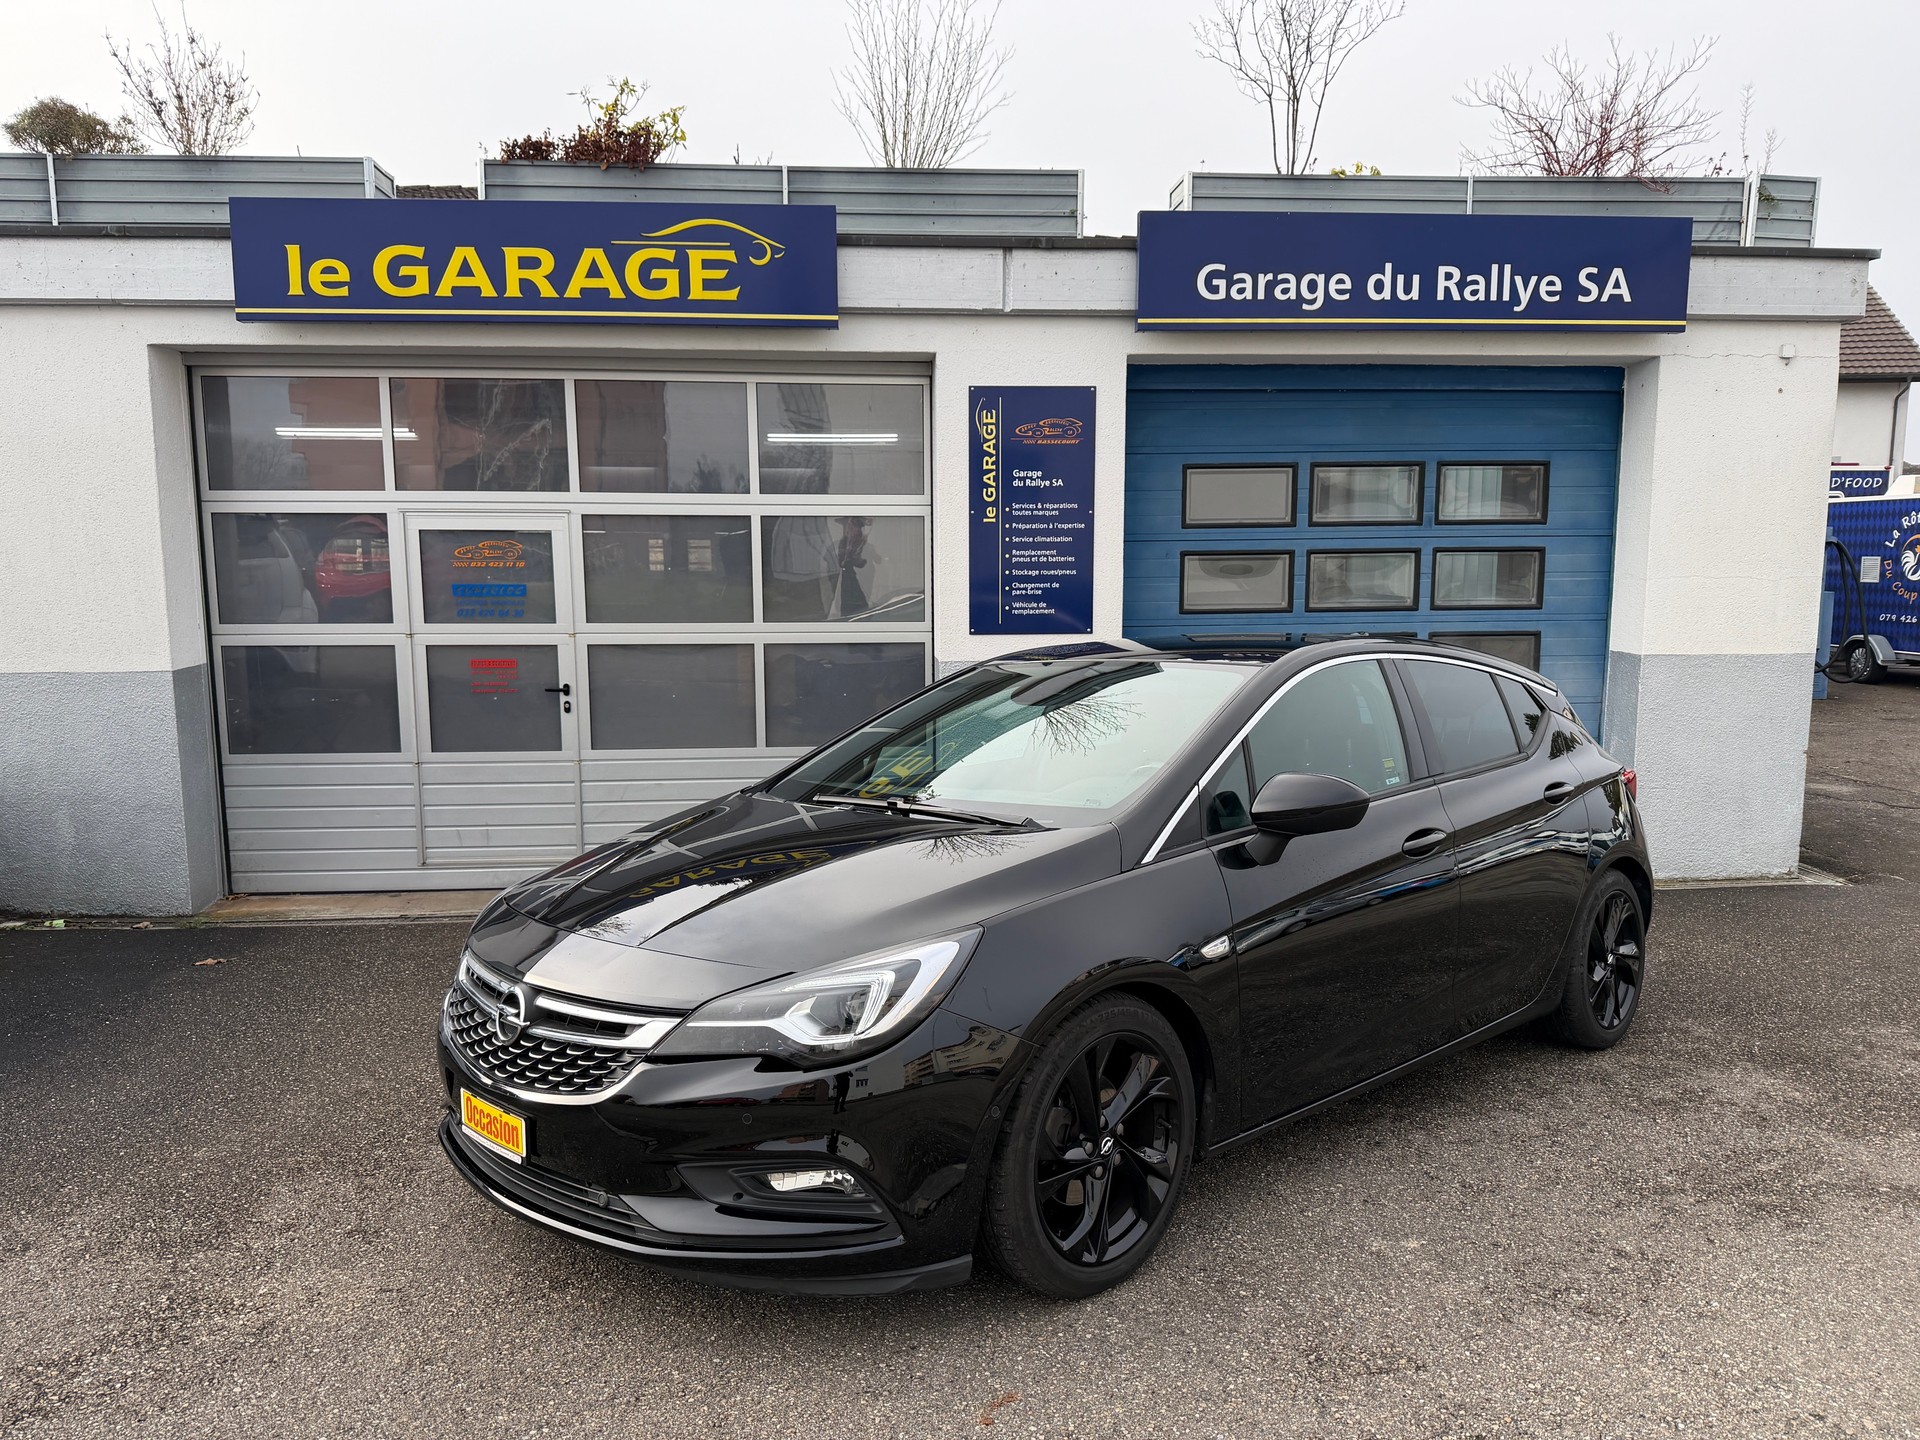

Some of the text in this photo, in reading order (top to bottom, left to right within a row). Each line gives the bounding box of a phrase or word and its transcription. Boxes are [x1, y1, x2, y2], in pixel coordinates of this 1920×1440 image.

[286, 244, 741, 301] le GARAGE
[1196, 262, 1632, 312] Garage du Rallye SA
[982, 409, 997, 523] le GARAGE
[1012, 470, 1042, 478] Garage
[1026, 479, 1050, 488] Rallye
[1884, 529, 1901, 548] La
[1883, 559, 1918, 605] Du Coup
[1879, 613, 1918, 623] 079 426
[465, 1096, 520, 1150] Occasion
